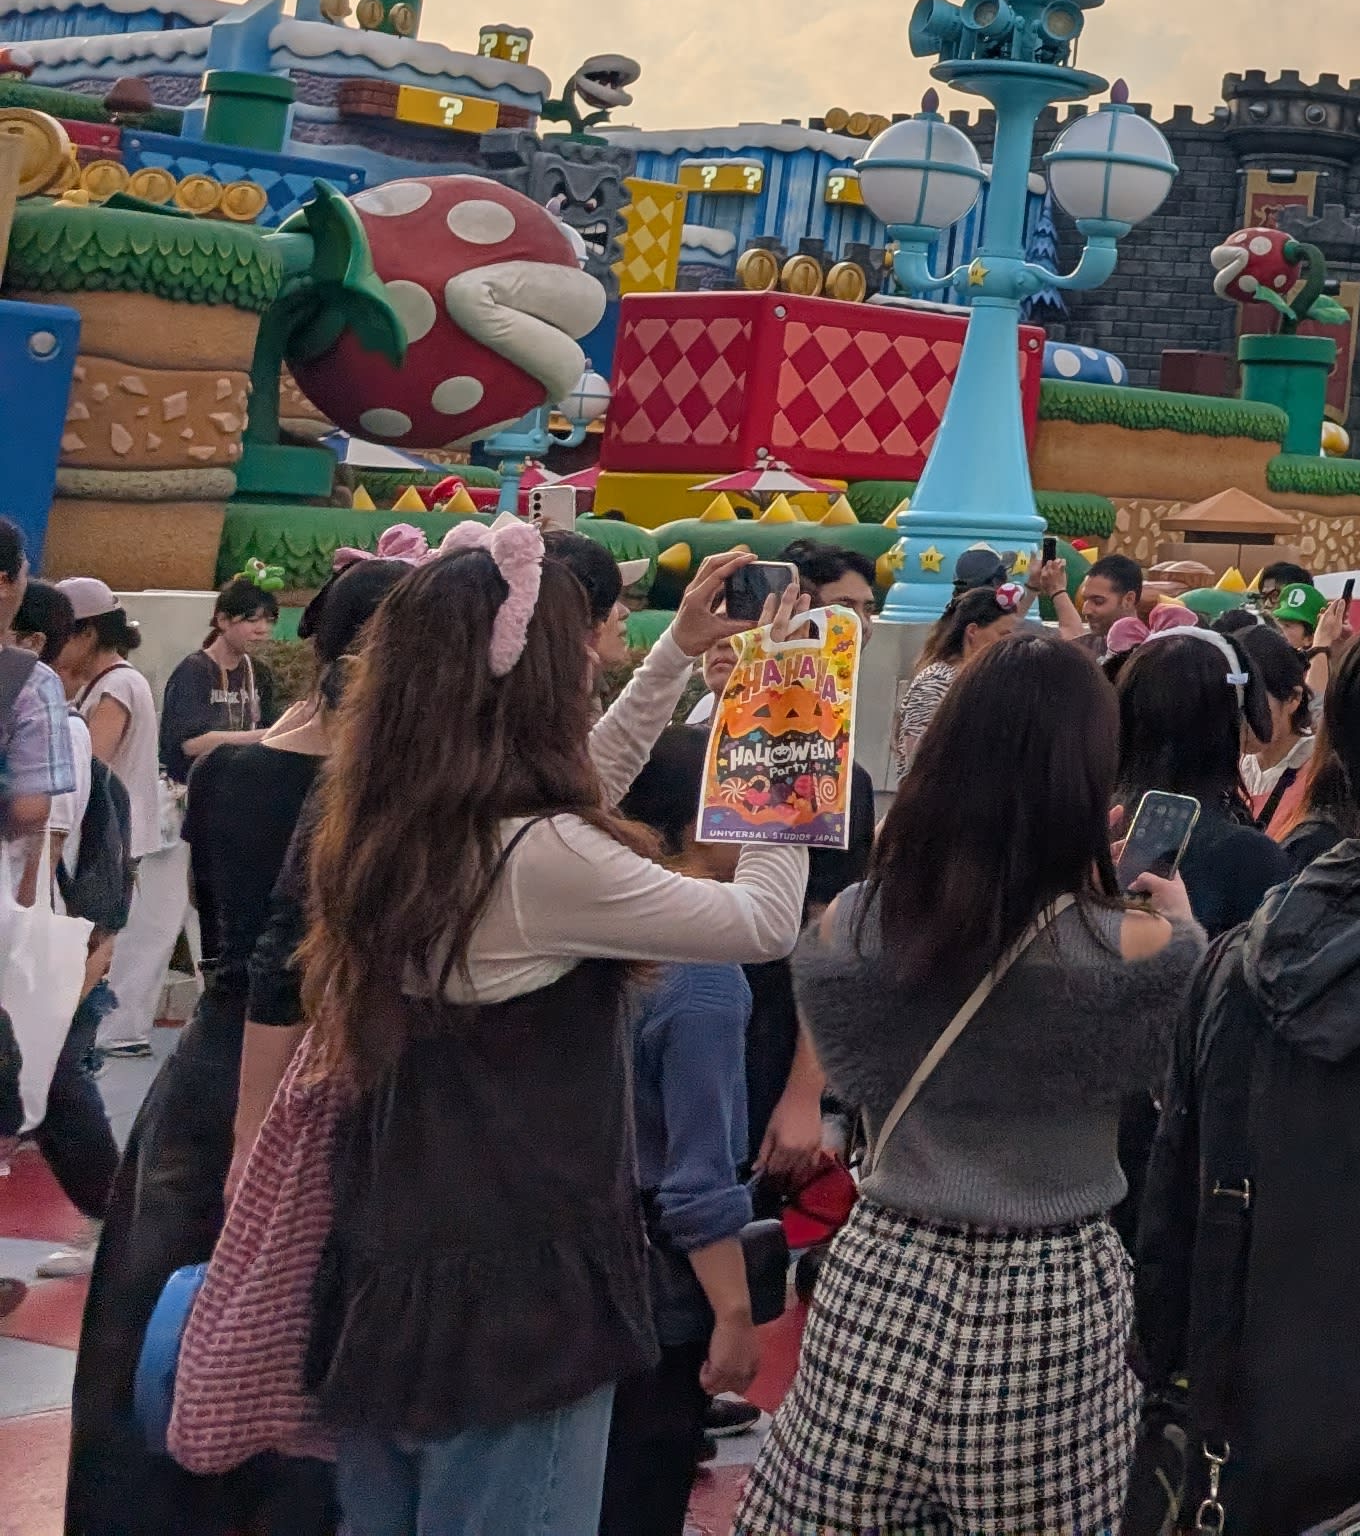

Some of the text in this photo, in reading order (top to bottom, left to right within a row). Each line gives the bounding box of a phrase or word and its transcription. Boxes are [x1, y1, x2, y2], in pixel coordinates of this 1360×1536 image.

[730, 738, 835, 772] HALLOWEEN
[769, 762, 809, 779] Party
[709, 829, 840, 843] UNIVERSAL STUDIOS JAPAN
